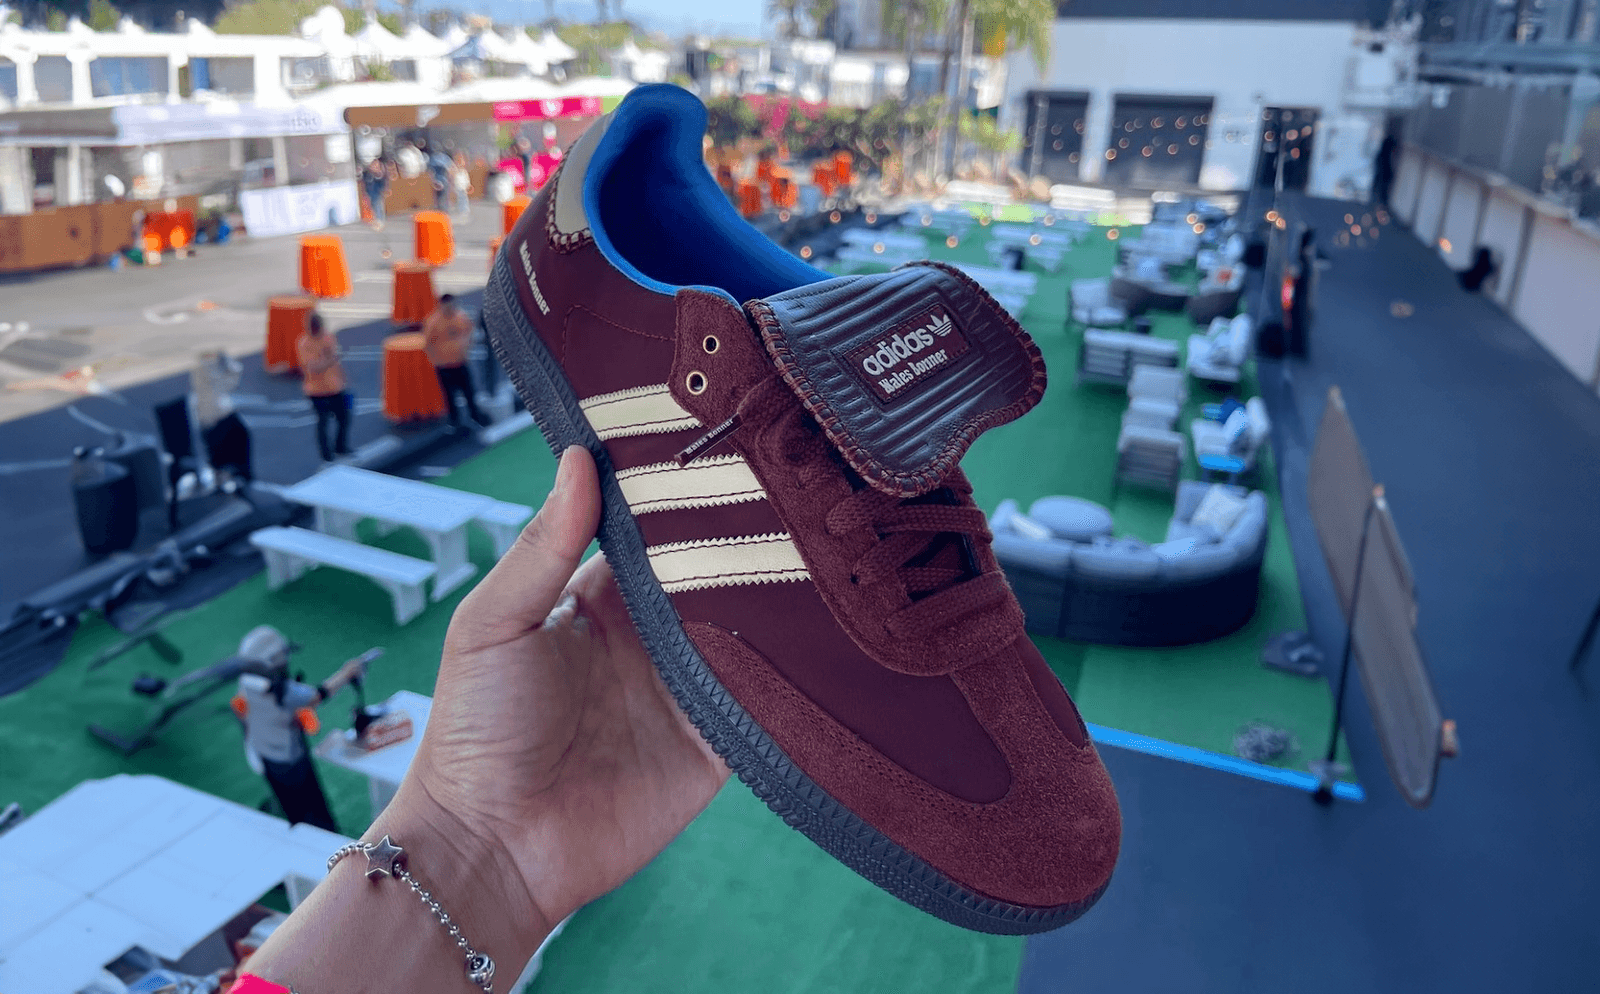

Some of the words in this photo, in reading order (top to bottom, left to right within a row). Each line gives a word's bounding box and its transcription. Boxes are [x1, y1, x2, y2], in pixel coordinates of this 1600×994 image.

[862, 327, 934, 376] adidas
[877, 369, 914, 394] Wales
[684, 436, 709, 455] Wales
